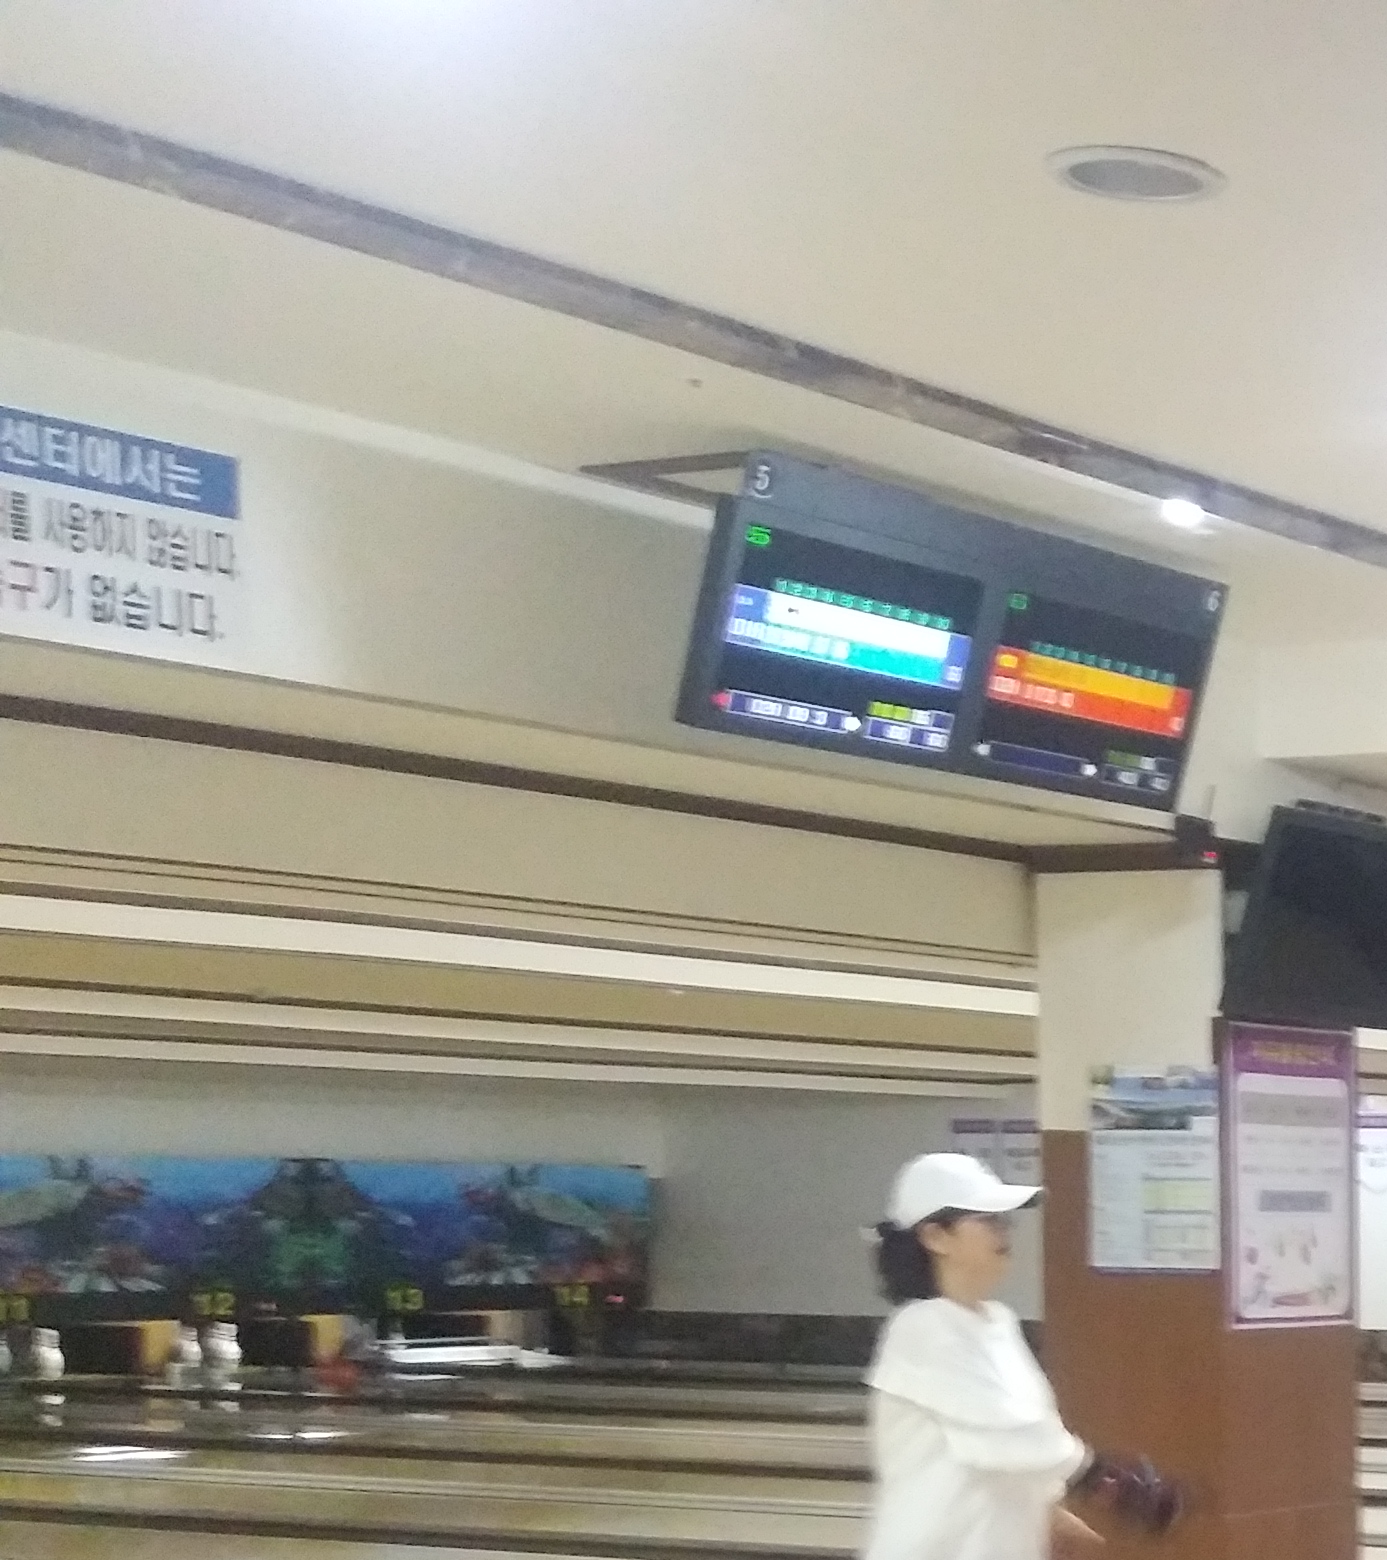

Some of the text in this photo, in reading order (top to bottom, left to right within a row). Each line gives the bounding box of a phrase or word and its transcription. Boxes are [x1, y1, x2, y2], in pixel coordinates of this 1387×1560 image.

[1, 416, 202, 502] 센터에서는
[755, 464, 772, 491] 5
[745, 525, 772, 546] 5
